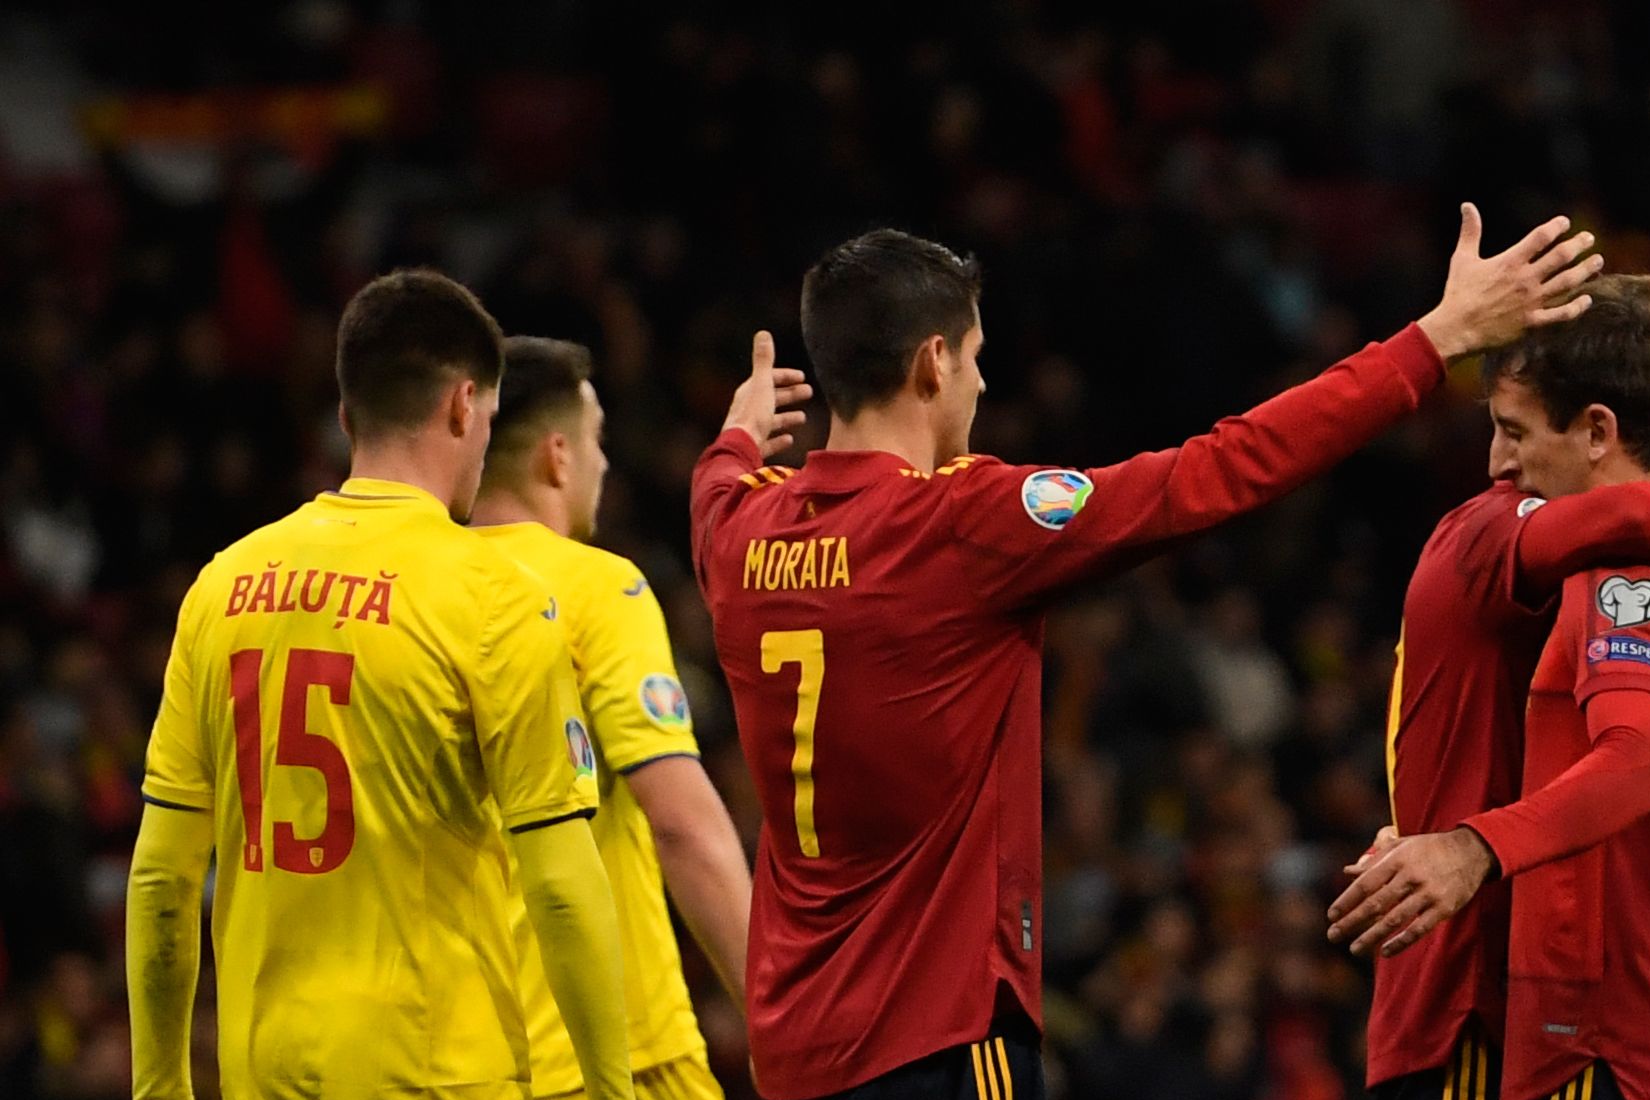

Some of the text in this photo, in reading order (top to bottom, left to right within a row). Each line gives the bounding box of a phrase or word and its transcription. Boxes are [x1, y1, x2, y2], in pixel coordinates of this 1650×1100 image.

[225, 560, 400, 629] BĂLUȚĂ
[743, 537, 851, 591] MORATA
[229, 649, 356, 875] 15
[760, 629, 825, 858] 7
